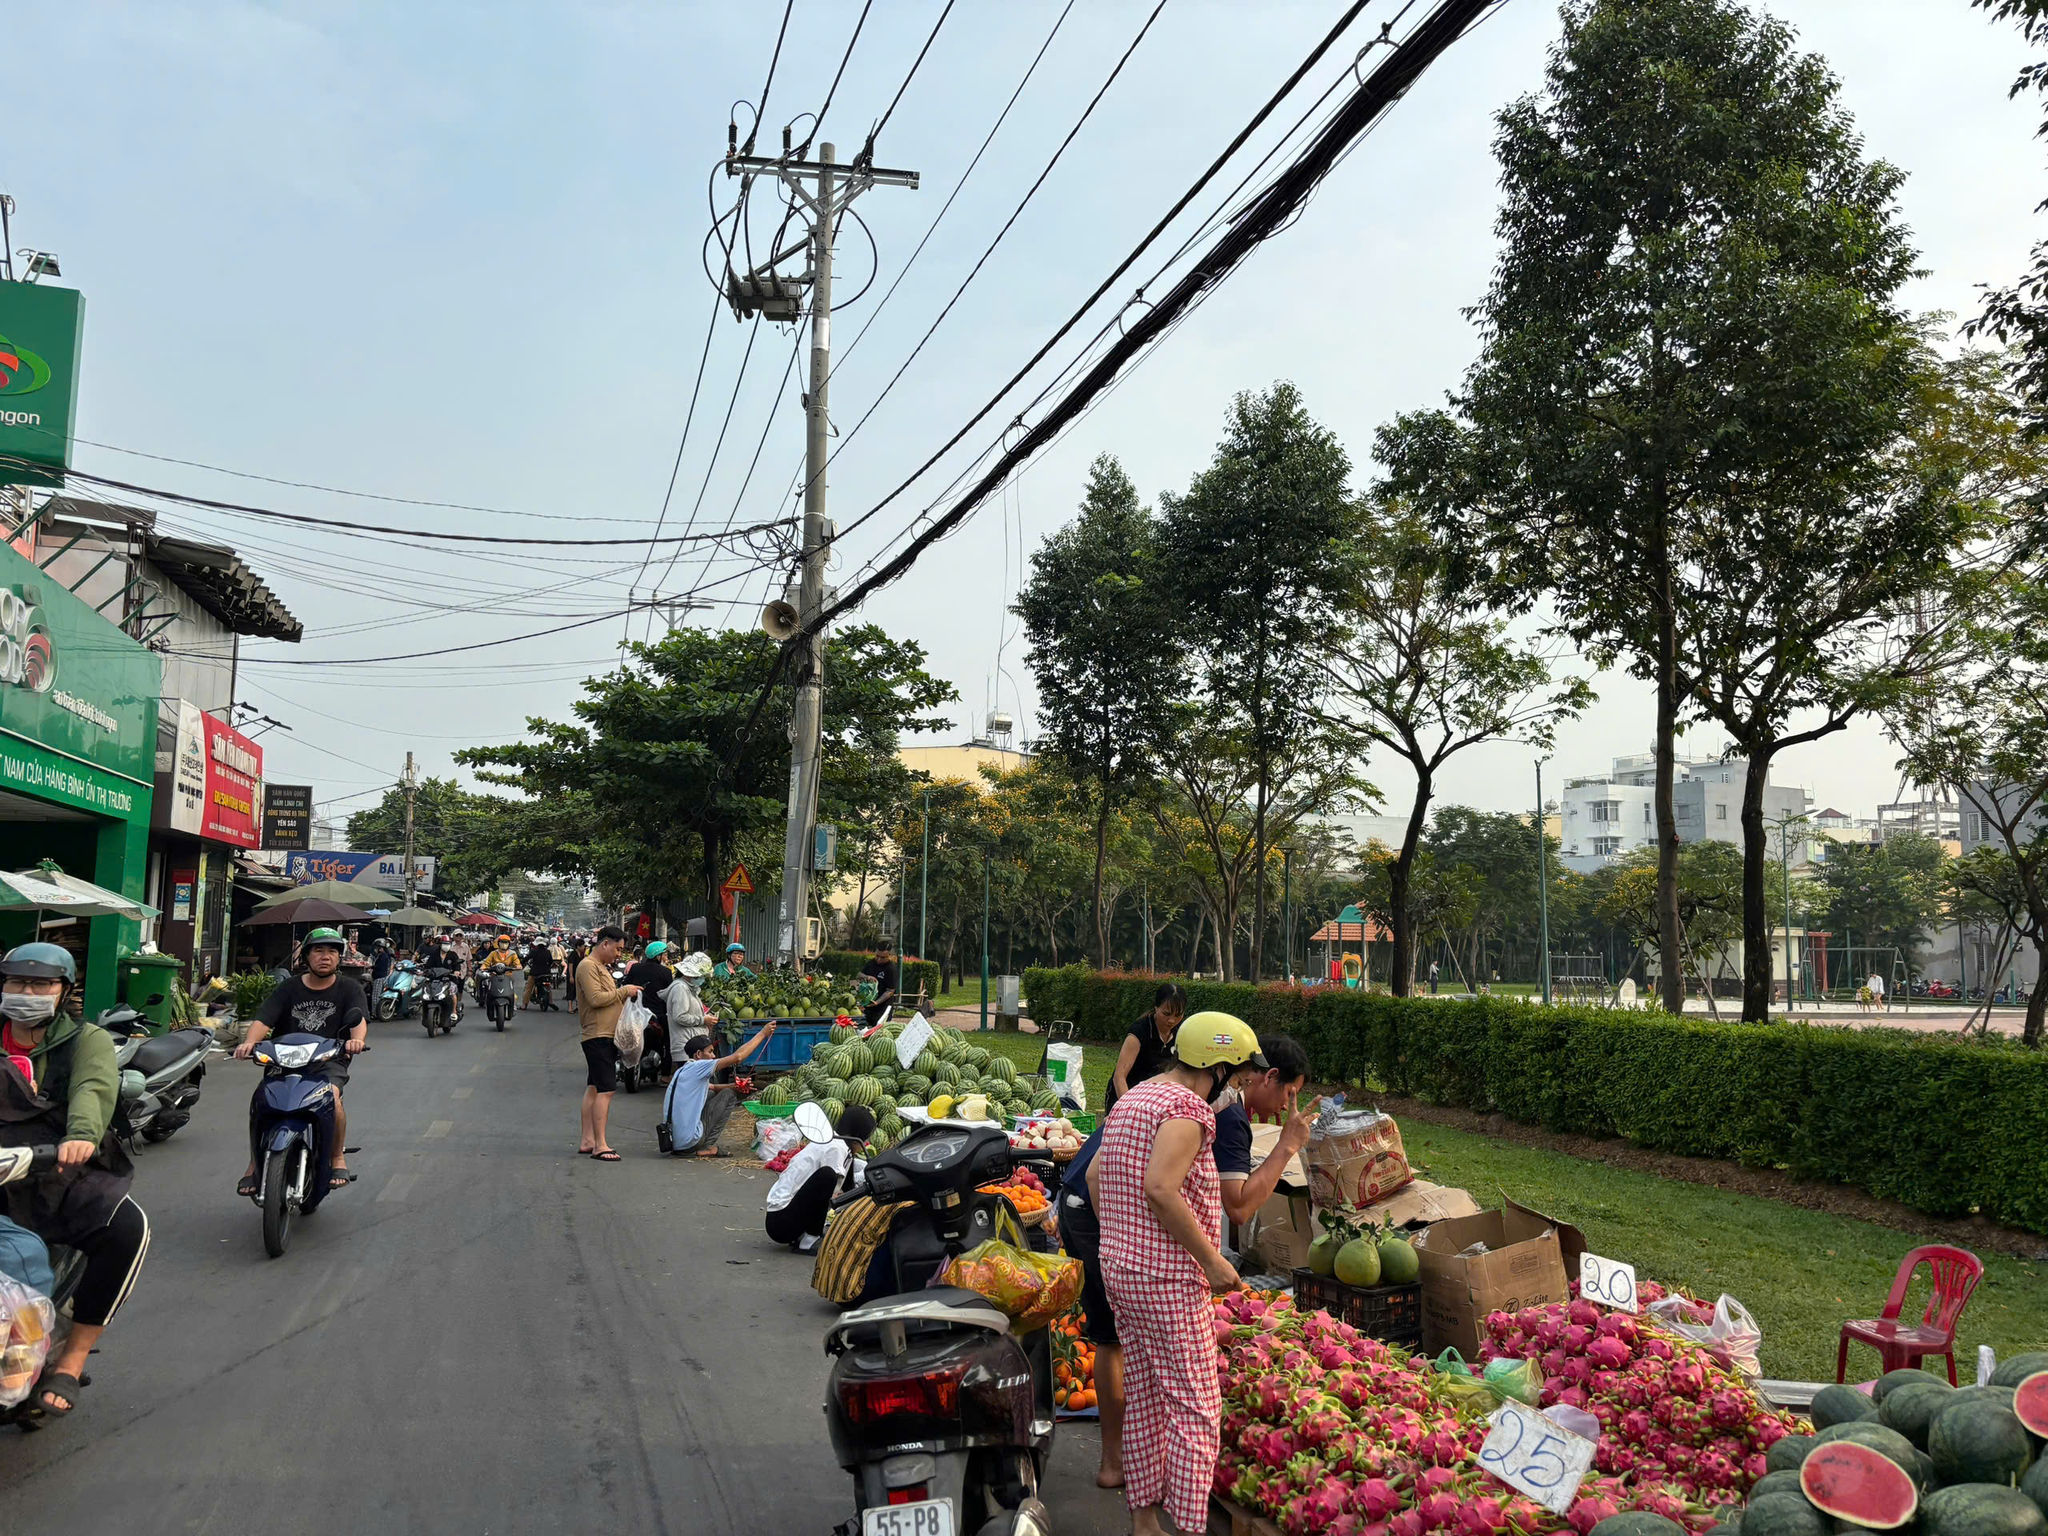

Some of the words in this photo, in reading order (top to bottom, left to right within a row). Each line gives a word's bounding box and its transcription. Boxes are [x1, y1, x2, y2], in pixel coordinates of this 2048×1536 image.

[3, 756, 25, 781] NAM
[310, 858, 356, 881] Tiger
[379, 862, 394, 874] BA
[1584, 1257, 1632, 1304] 20
[887, 1441, 924, 1452] HONDA
[1481, 1409, 1567, 1488] 25
